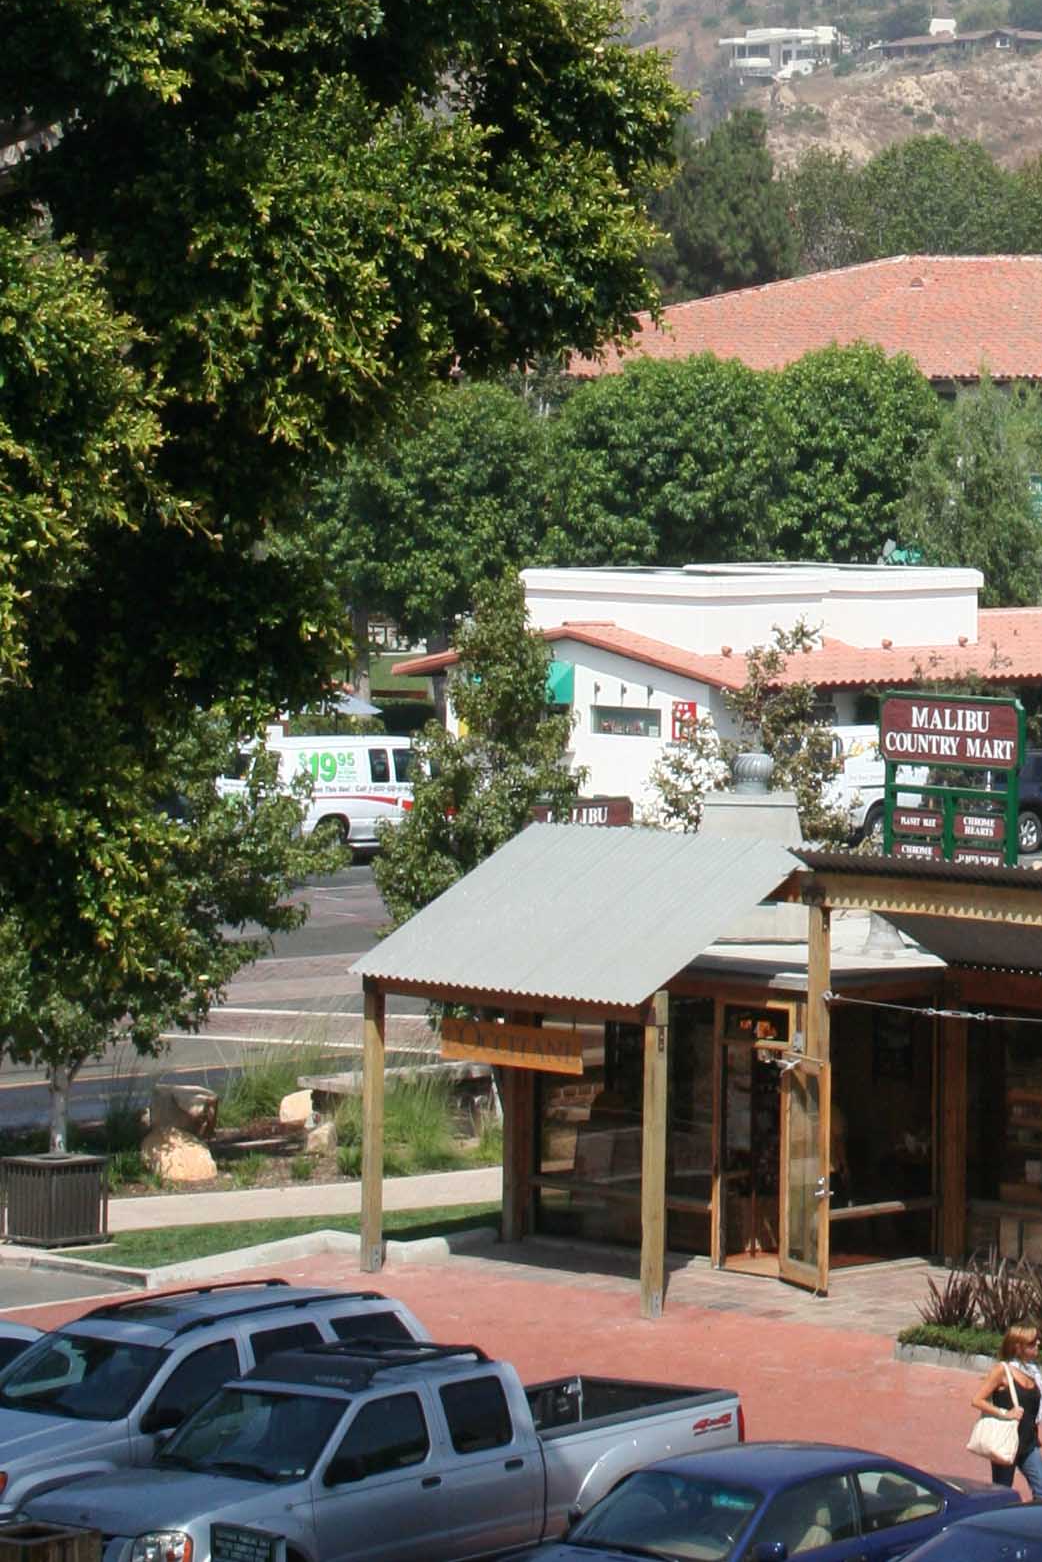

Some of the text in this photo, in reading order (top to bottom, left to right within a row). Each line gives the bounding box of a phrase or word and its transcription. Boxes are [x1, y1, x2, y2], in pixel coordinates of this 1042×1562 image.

[911, 706, 990, 733] MALIBU
[885, 732, 961, 756] COUNTRY
[966, 737, 1014, 760] MART
[963, 816, 996, 828] CHROME
[964, 825, 994, 837] HEARTS
[901, 844, 934, 855] CHROME
